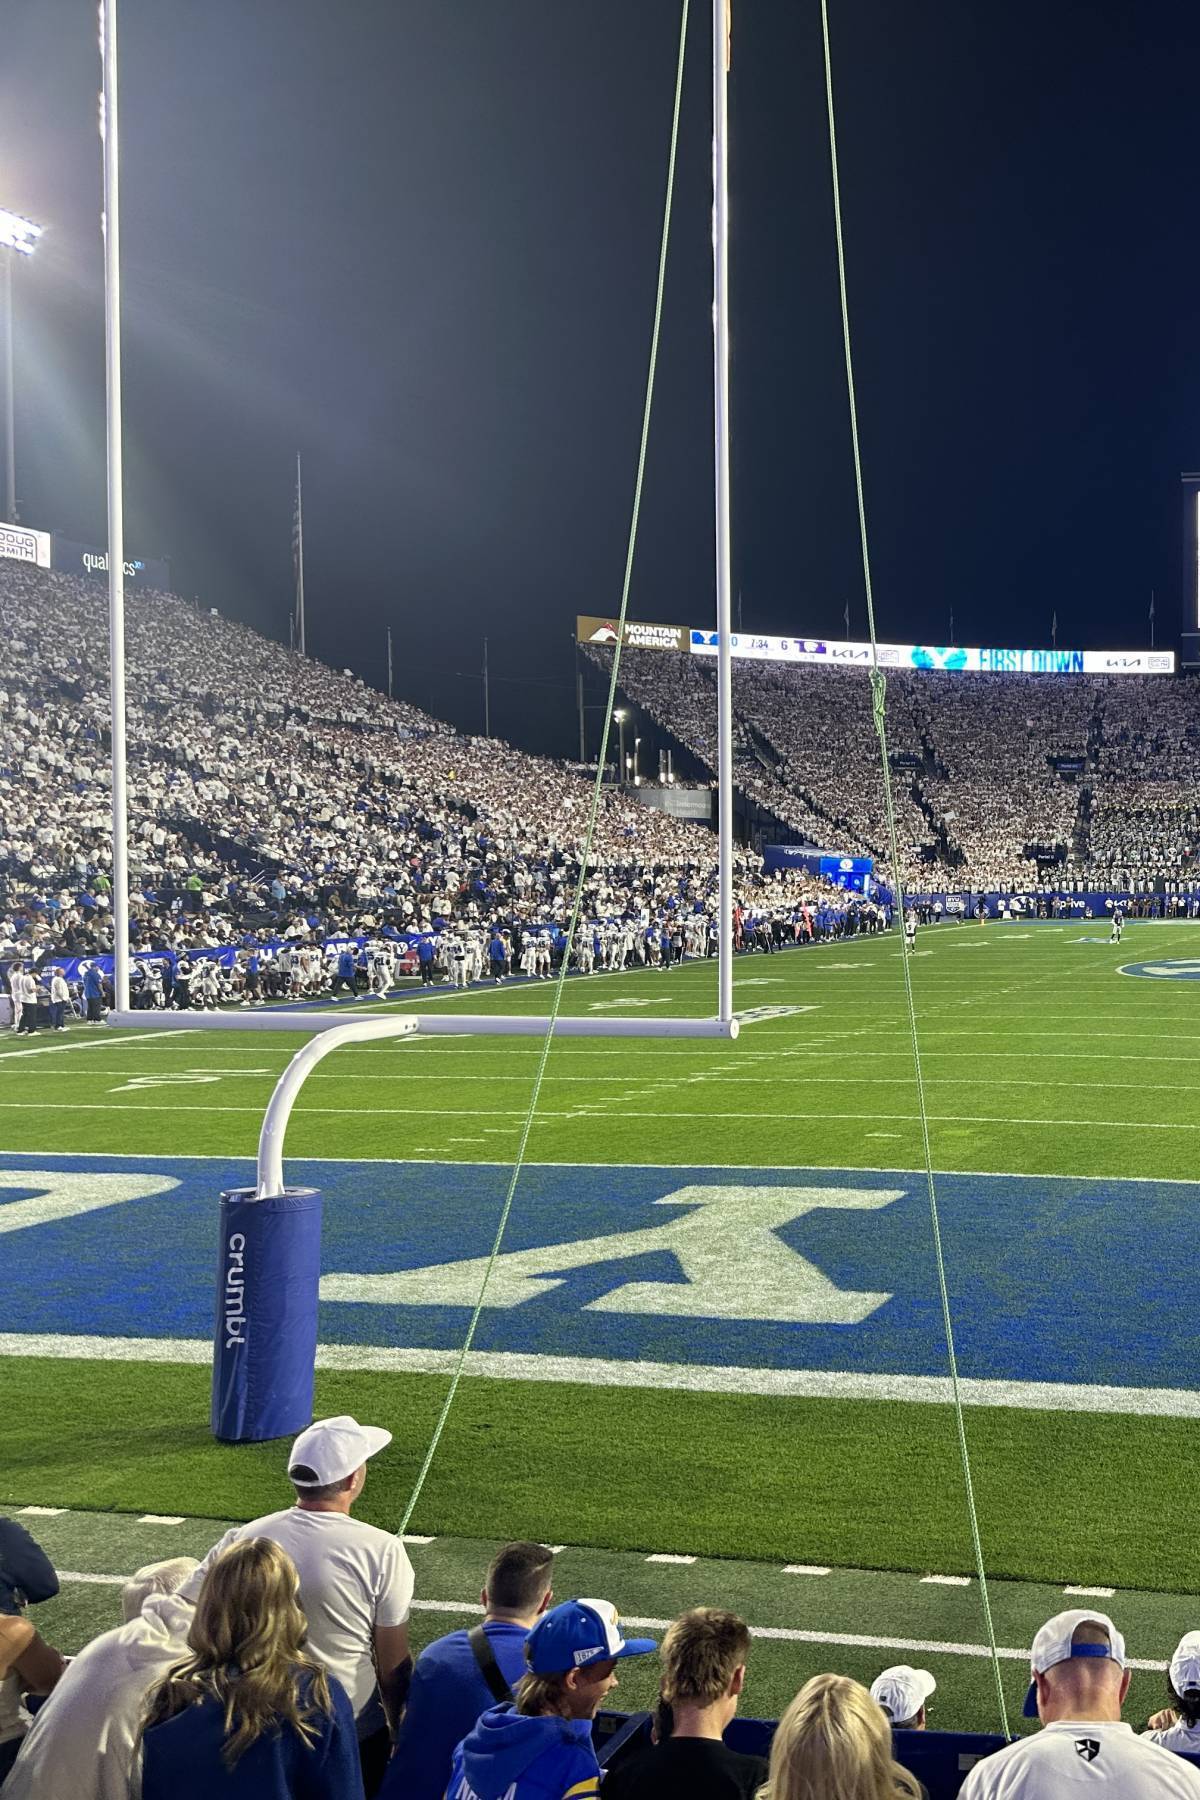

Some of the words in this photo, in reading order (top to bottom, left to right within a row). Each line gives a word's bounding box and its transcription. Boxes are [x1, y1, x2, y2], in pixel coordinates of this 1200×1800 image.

[625, 623, 682, 639] MOUNTAIN
[627, 635, 679, 649] AMERICA
[750, 637, 769, 649] 7:34
[979, 648, 1025, 672] FIRST
[225, 1233, 247, 1349] crumbl
